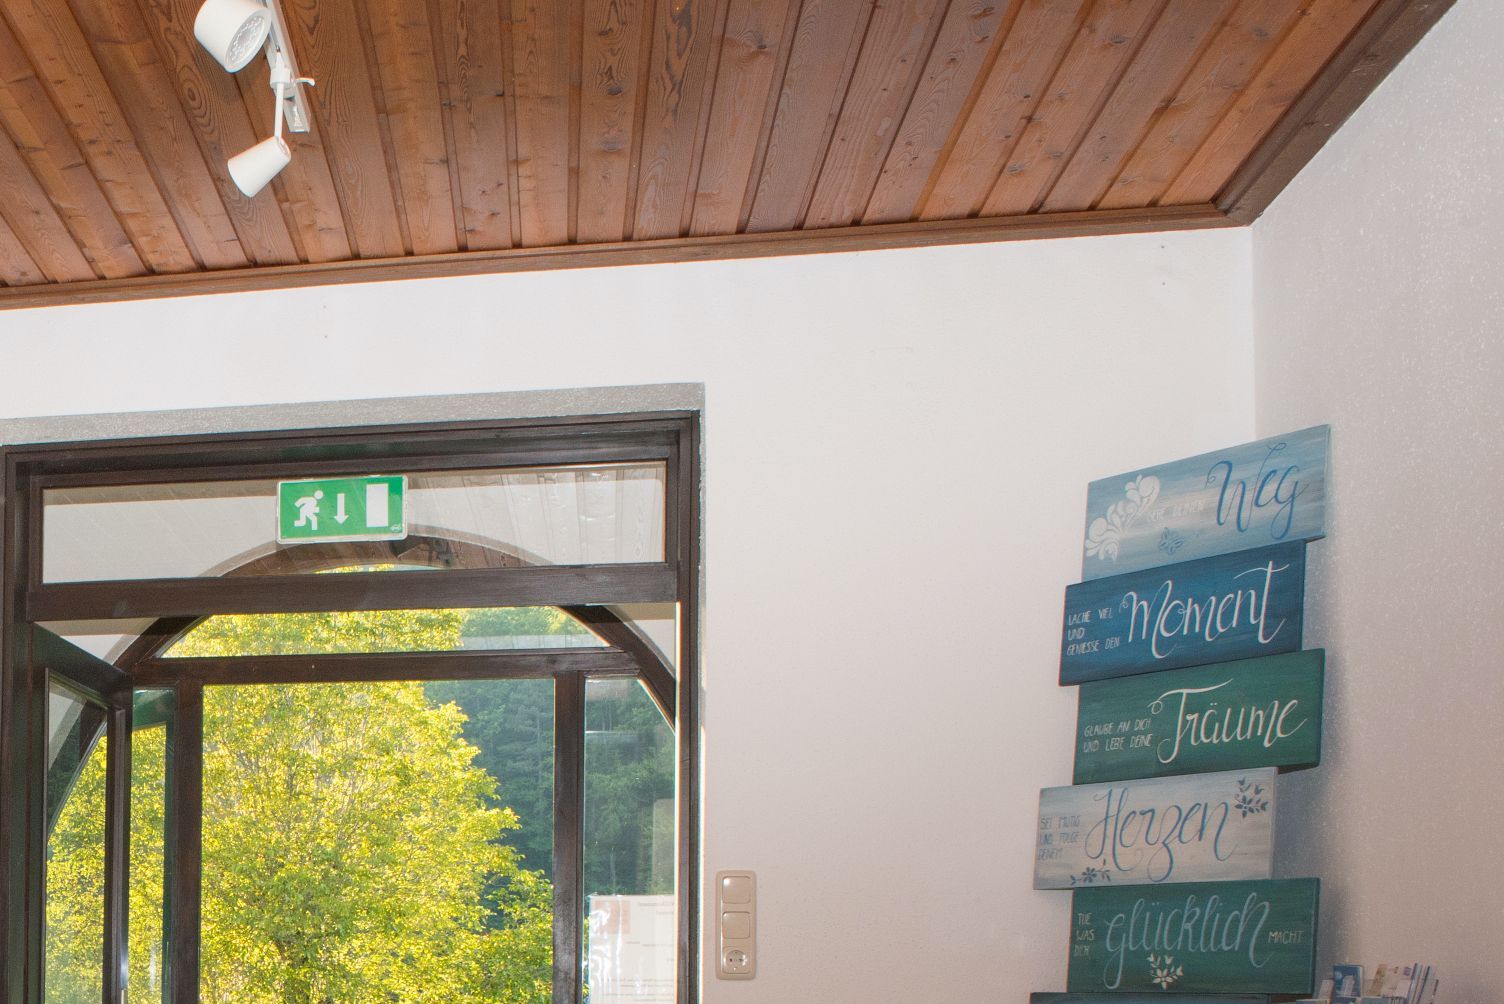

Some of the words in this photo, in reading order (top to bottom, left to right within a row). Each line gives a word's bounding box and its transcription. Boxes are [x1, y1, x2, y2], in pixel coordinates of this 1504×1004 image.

[1205, 442, 1309, 540] Weg
[1068, 611, 1092, 626] LACHE
[1098, 607, 1113, 620] VIEL
[1119, 561, 1290, 659] Moment
[1067, 627, 1085, 641] UND
[1105, 637, 1120, 650] DEN
[1084, 722, 1115, 737] GLAUBE
[1117, 720, 1131, 733] AN
[1147, 678, 1309, 764] Träume
[1083, 740, 1100, 753] UND
[1105, 737, 1126, 751] LEBE
[1129, 734, 1153, 748] DEINE
[1084, 787, 1237, 883] Herzen
[1077, 912, 1093, 926] TUE
[1076, 928, 1095, 941] WAS
[1103, 892, 1272, 990] glücklich
[1267, 930, 1305, 945] MACHT
